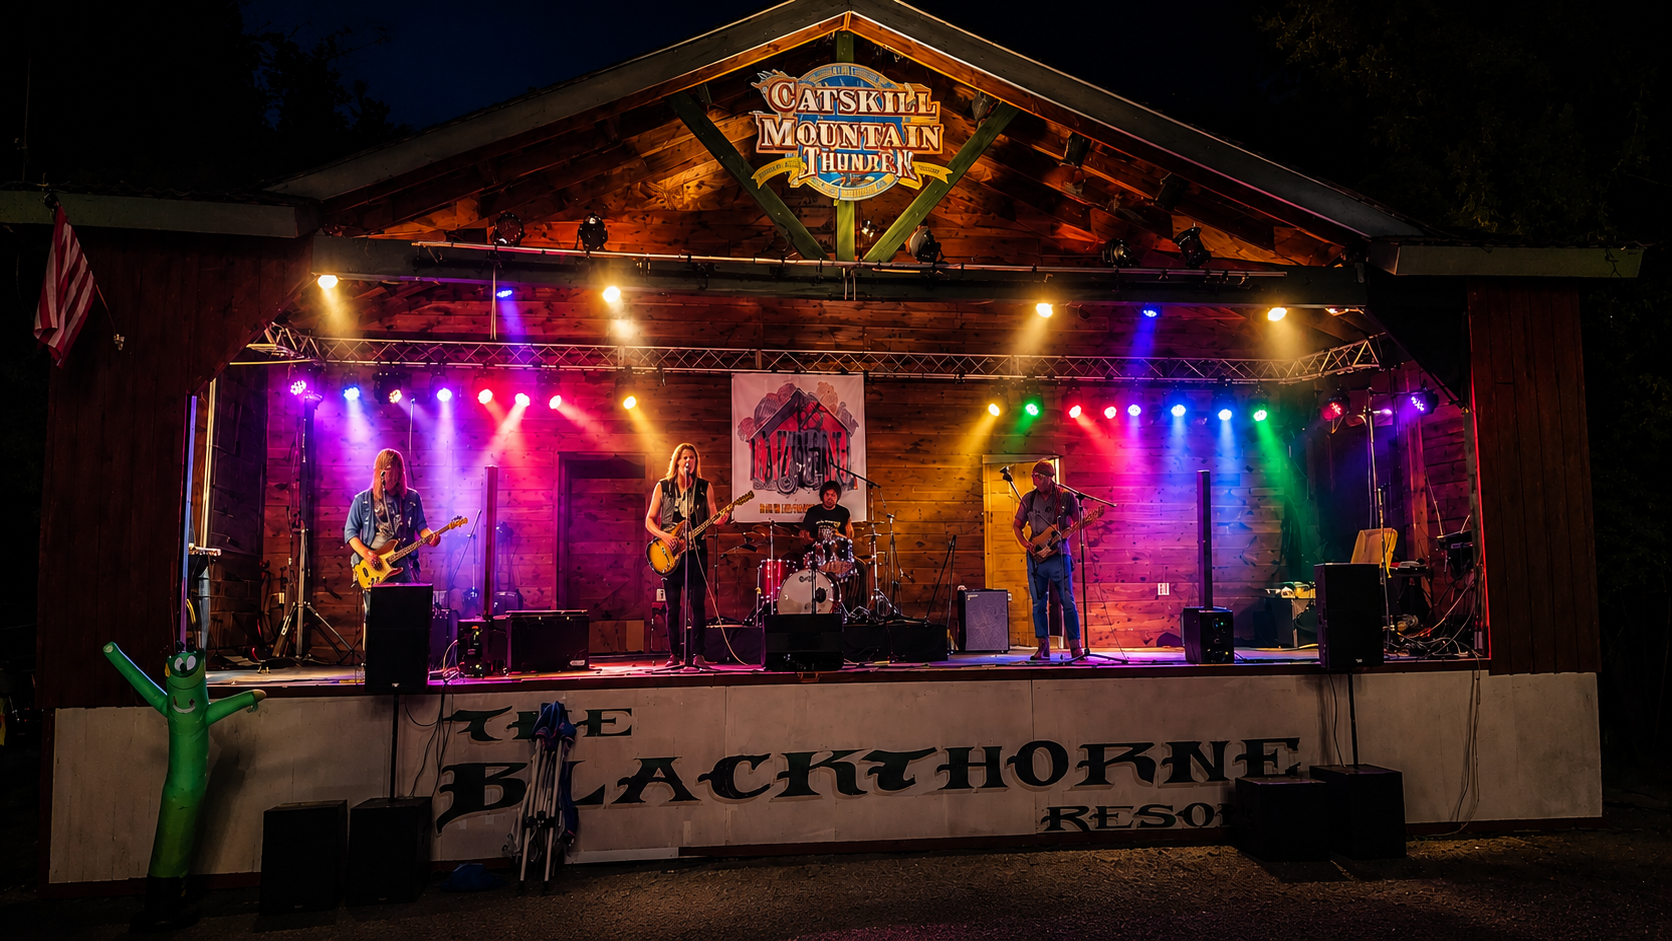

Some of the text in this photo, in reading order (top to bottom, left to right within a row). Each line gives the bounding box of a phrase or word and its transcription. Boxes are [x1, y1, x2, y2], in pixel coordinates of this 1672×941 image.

[768, 80, 937, 114] CATSKILL
[761, 118, 941, 149] MOUNTAIN
[436, 738, 1301, 836] BLACKTHORNE
